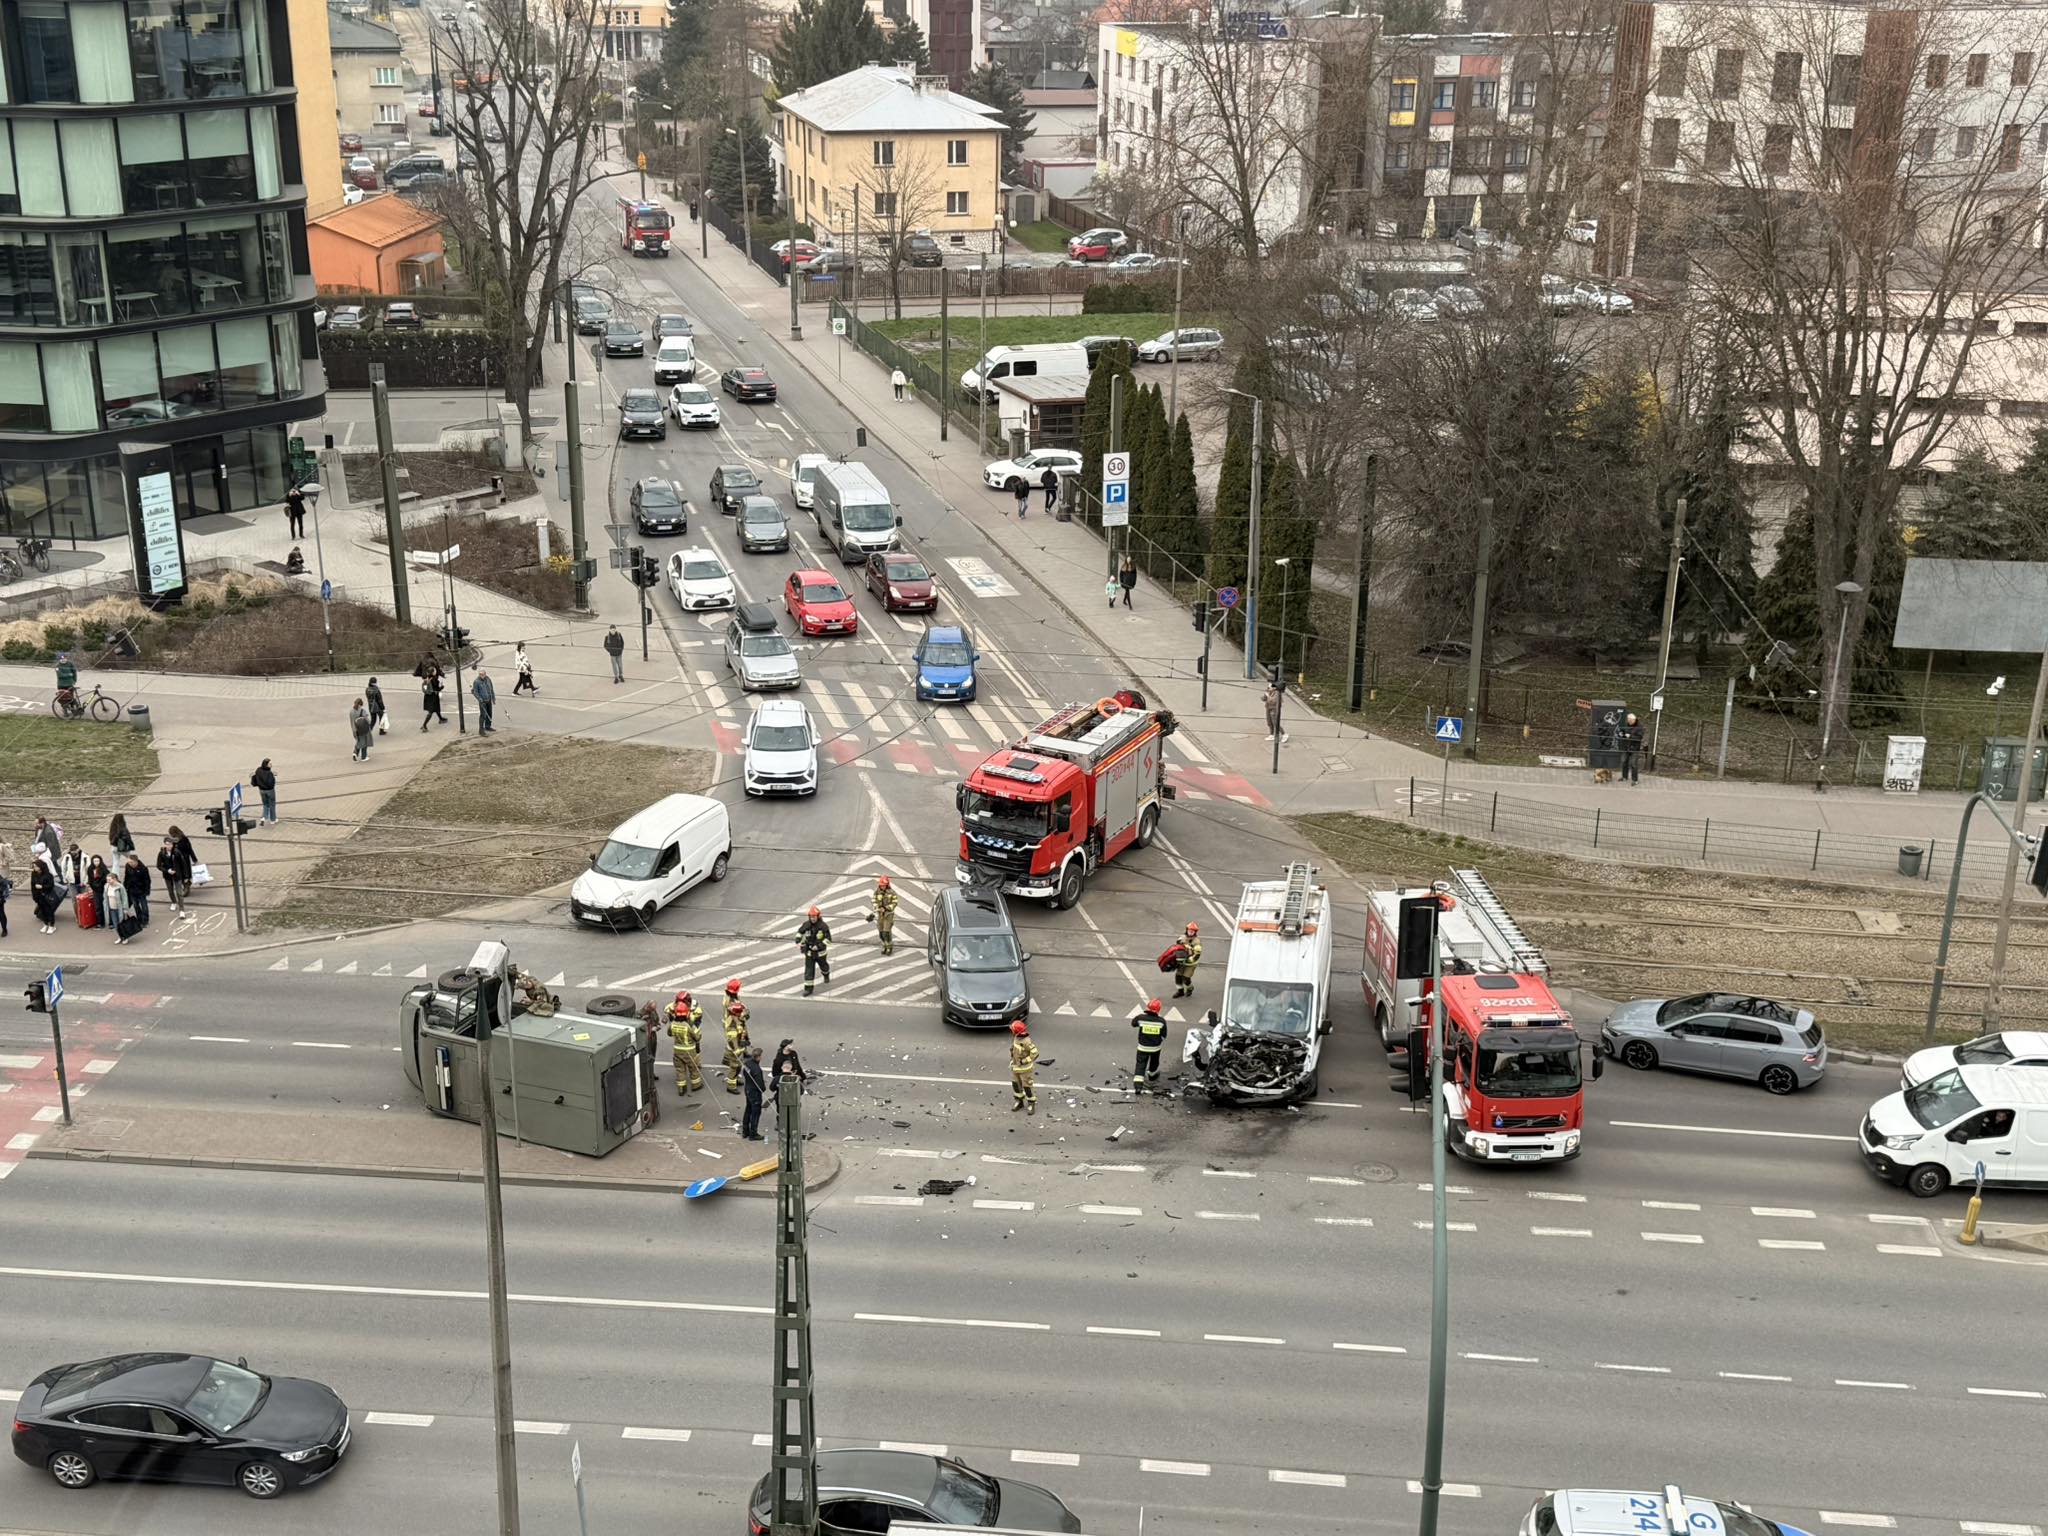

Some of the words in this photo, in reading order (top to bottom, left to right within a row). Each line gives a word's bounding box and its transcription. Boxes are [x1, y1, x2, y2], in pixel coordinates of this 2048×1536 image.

[1228, 11, 1274, 22] HOTEL
[1110, 462, 1123, 471] 30
[1110, 485, 1122, 502] P
[1630, 1497, 1662, 1533] 214
[1689, 1512, 1718, 1530] G
